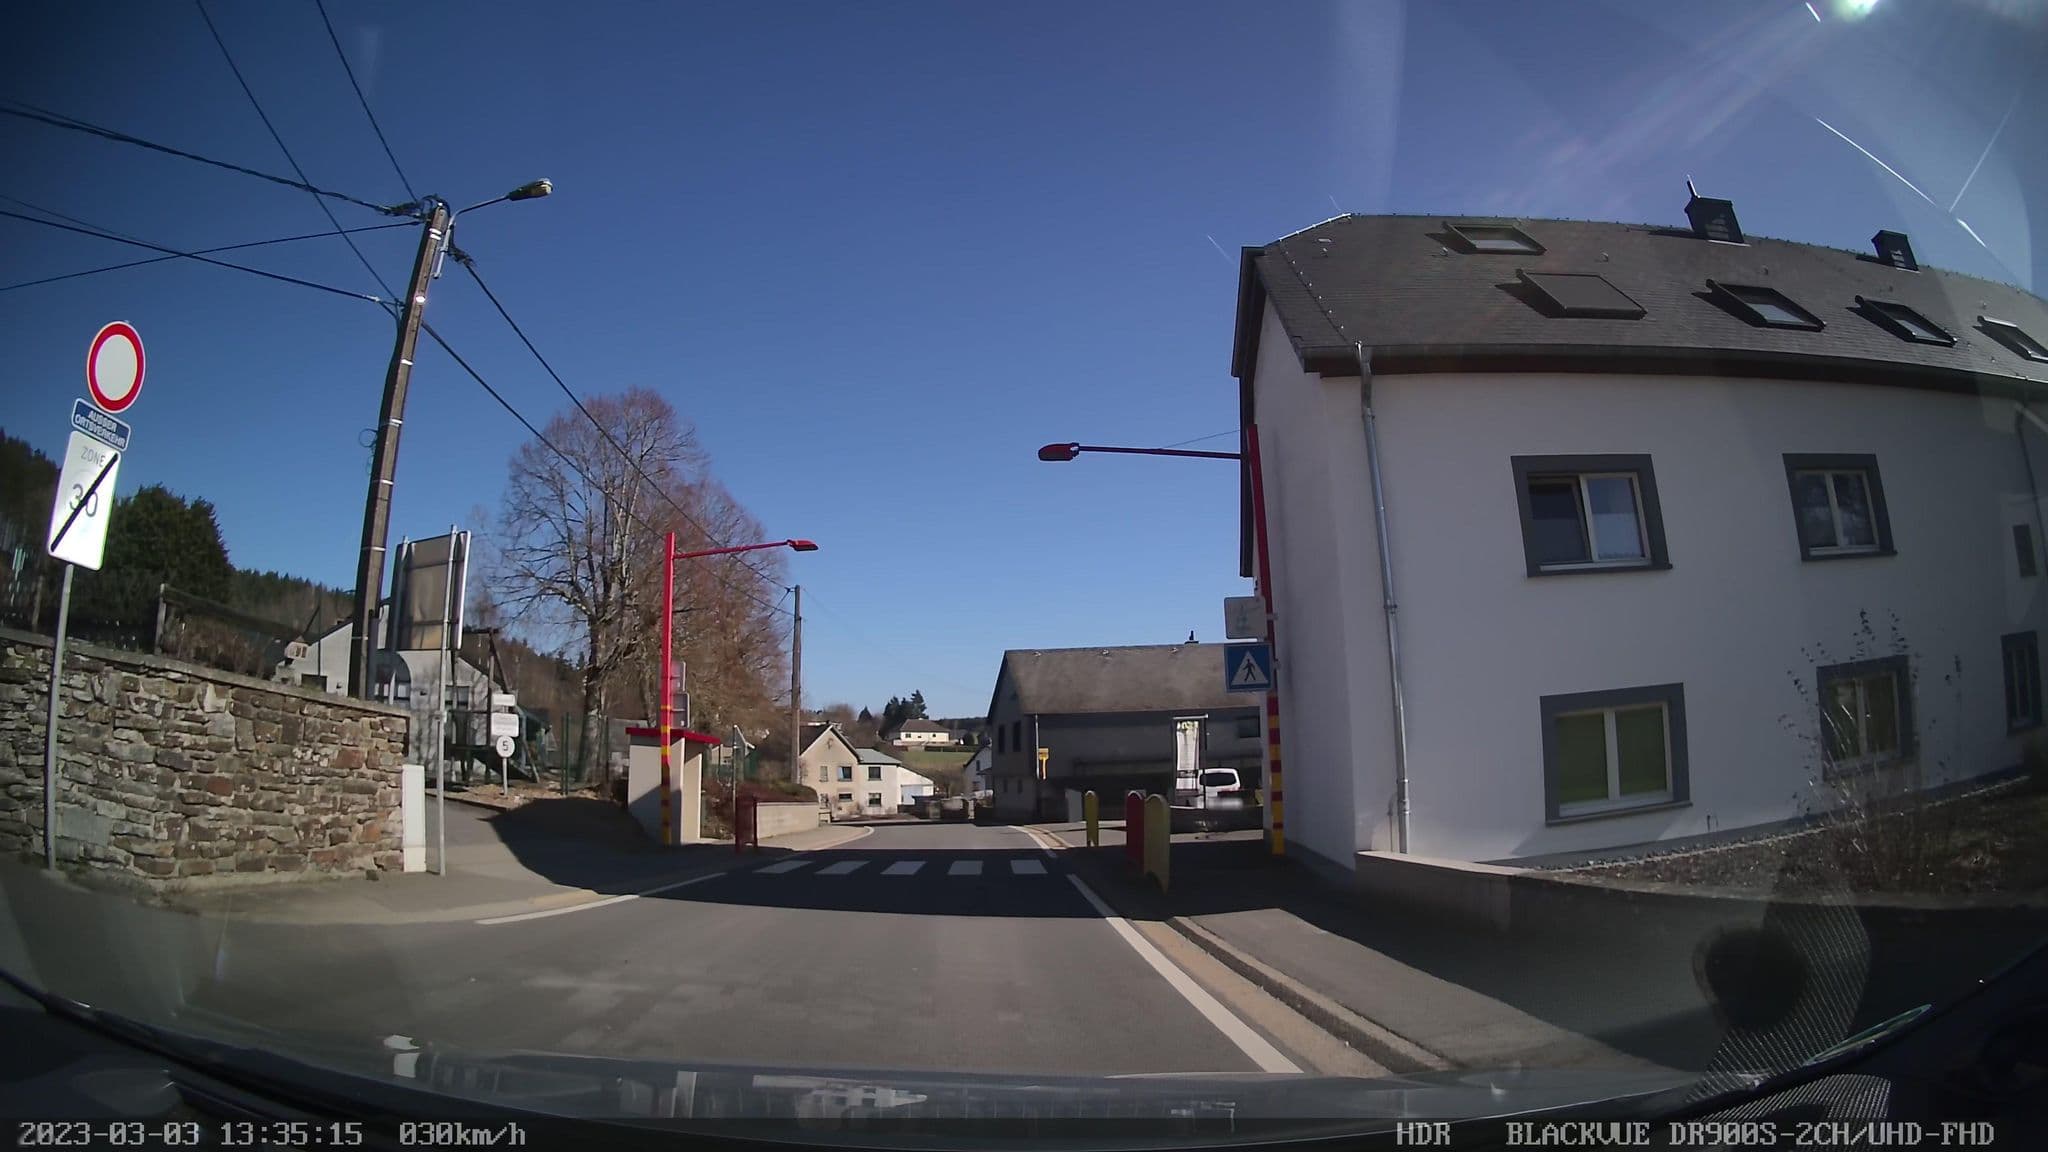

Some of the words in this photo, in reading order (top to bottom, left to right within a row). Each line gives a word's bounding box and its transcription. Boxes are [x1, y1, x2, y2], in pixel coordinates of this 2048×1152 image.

[75, 414, 126, 447] ORTSVERKEHR
[80, 446, 106, 468] ZONE
[69, 484, 99, 517] 30
[502, 740, 509, 751] 5
